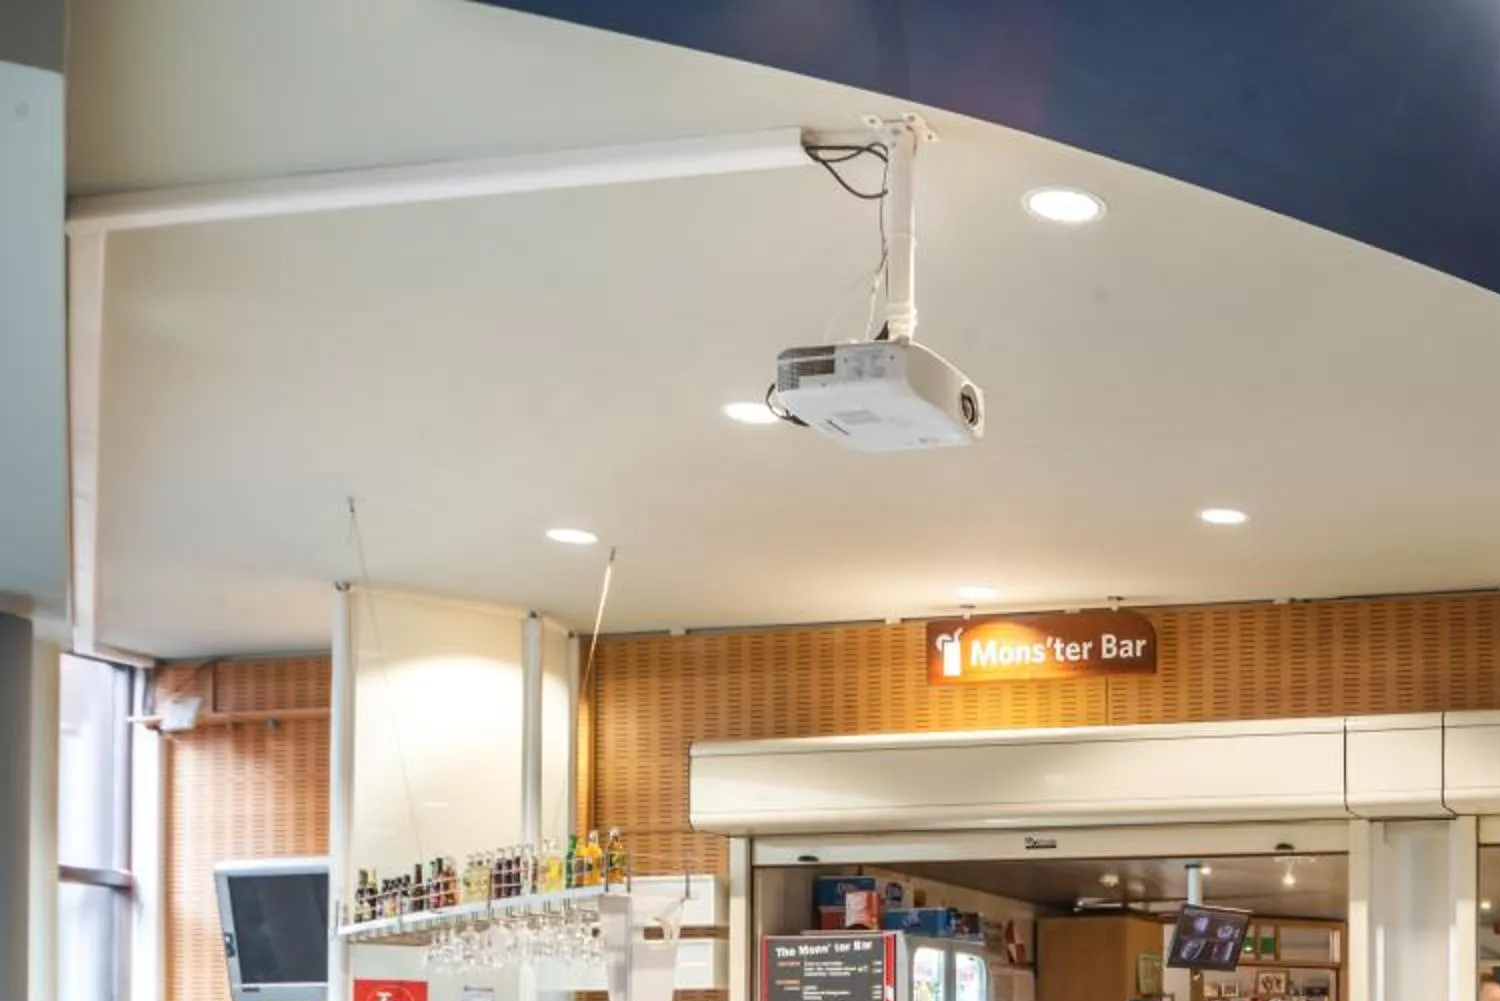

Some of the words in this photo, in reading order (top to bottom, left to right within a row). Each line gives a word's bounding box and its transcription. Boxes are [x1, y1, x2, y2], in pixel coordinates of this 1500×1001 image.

[969, 636, 1093, 667] Mons'ter
[1101, 633, 1147, 659] Bar
[776, 947, 796, 957] The
